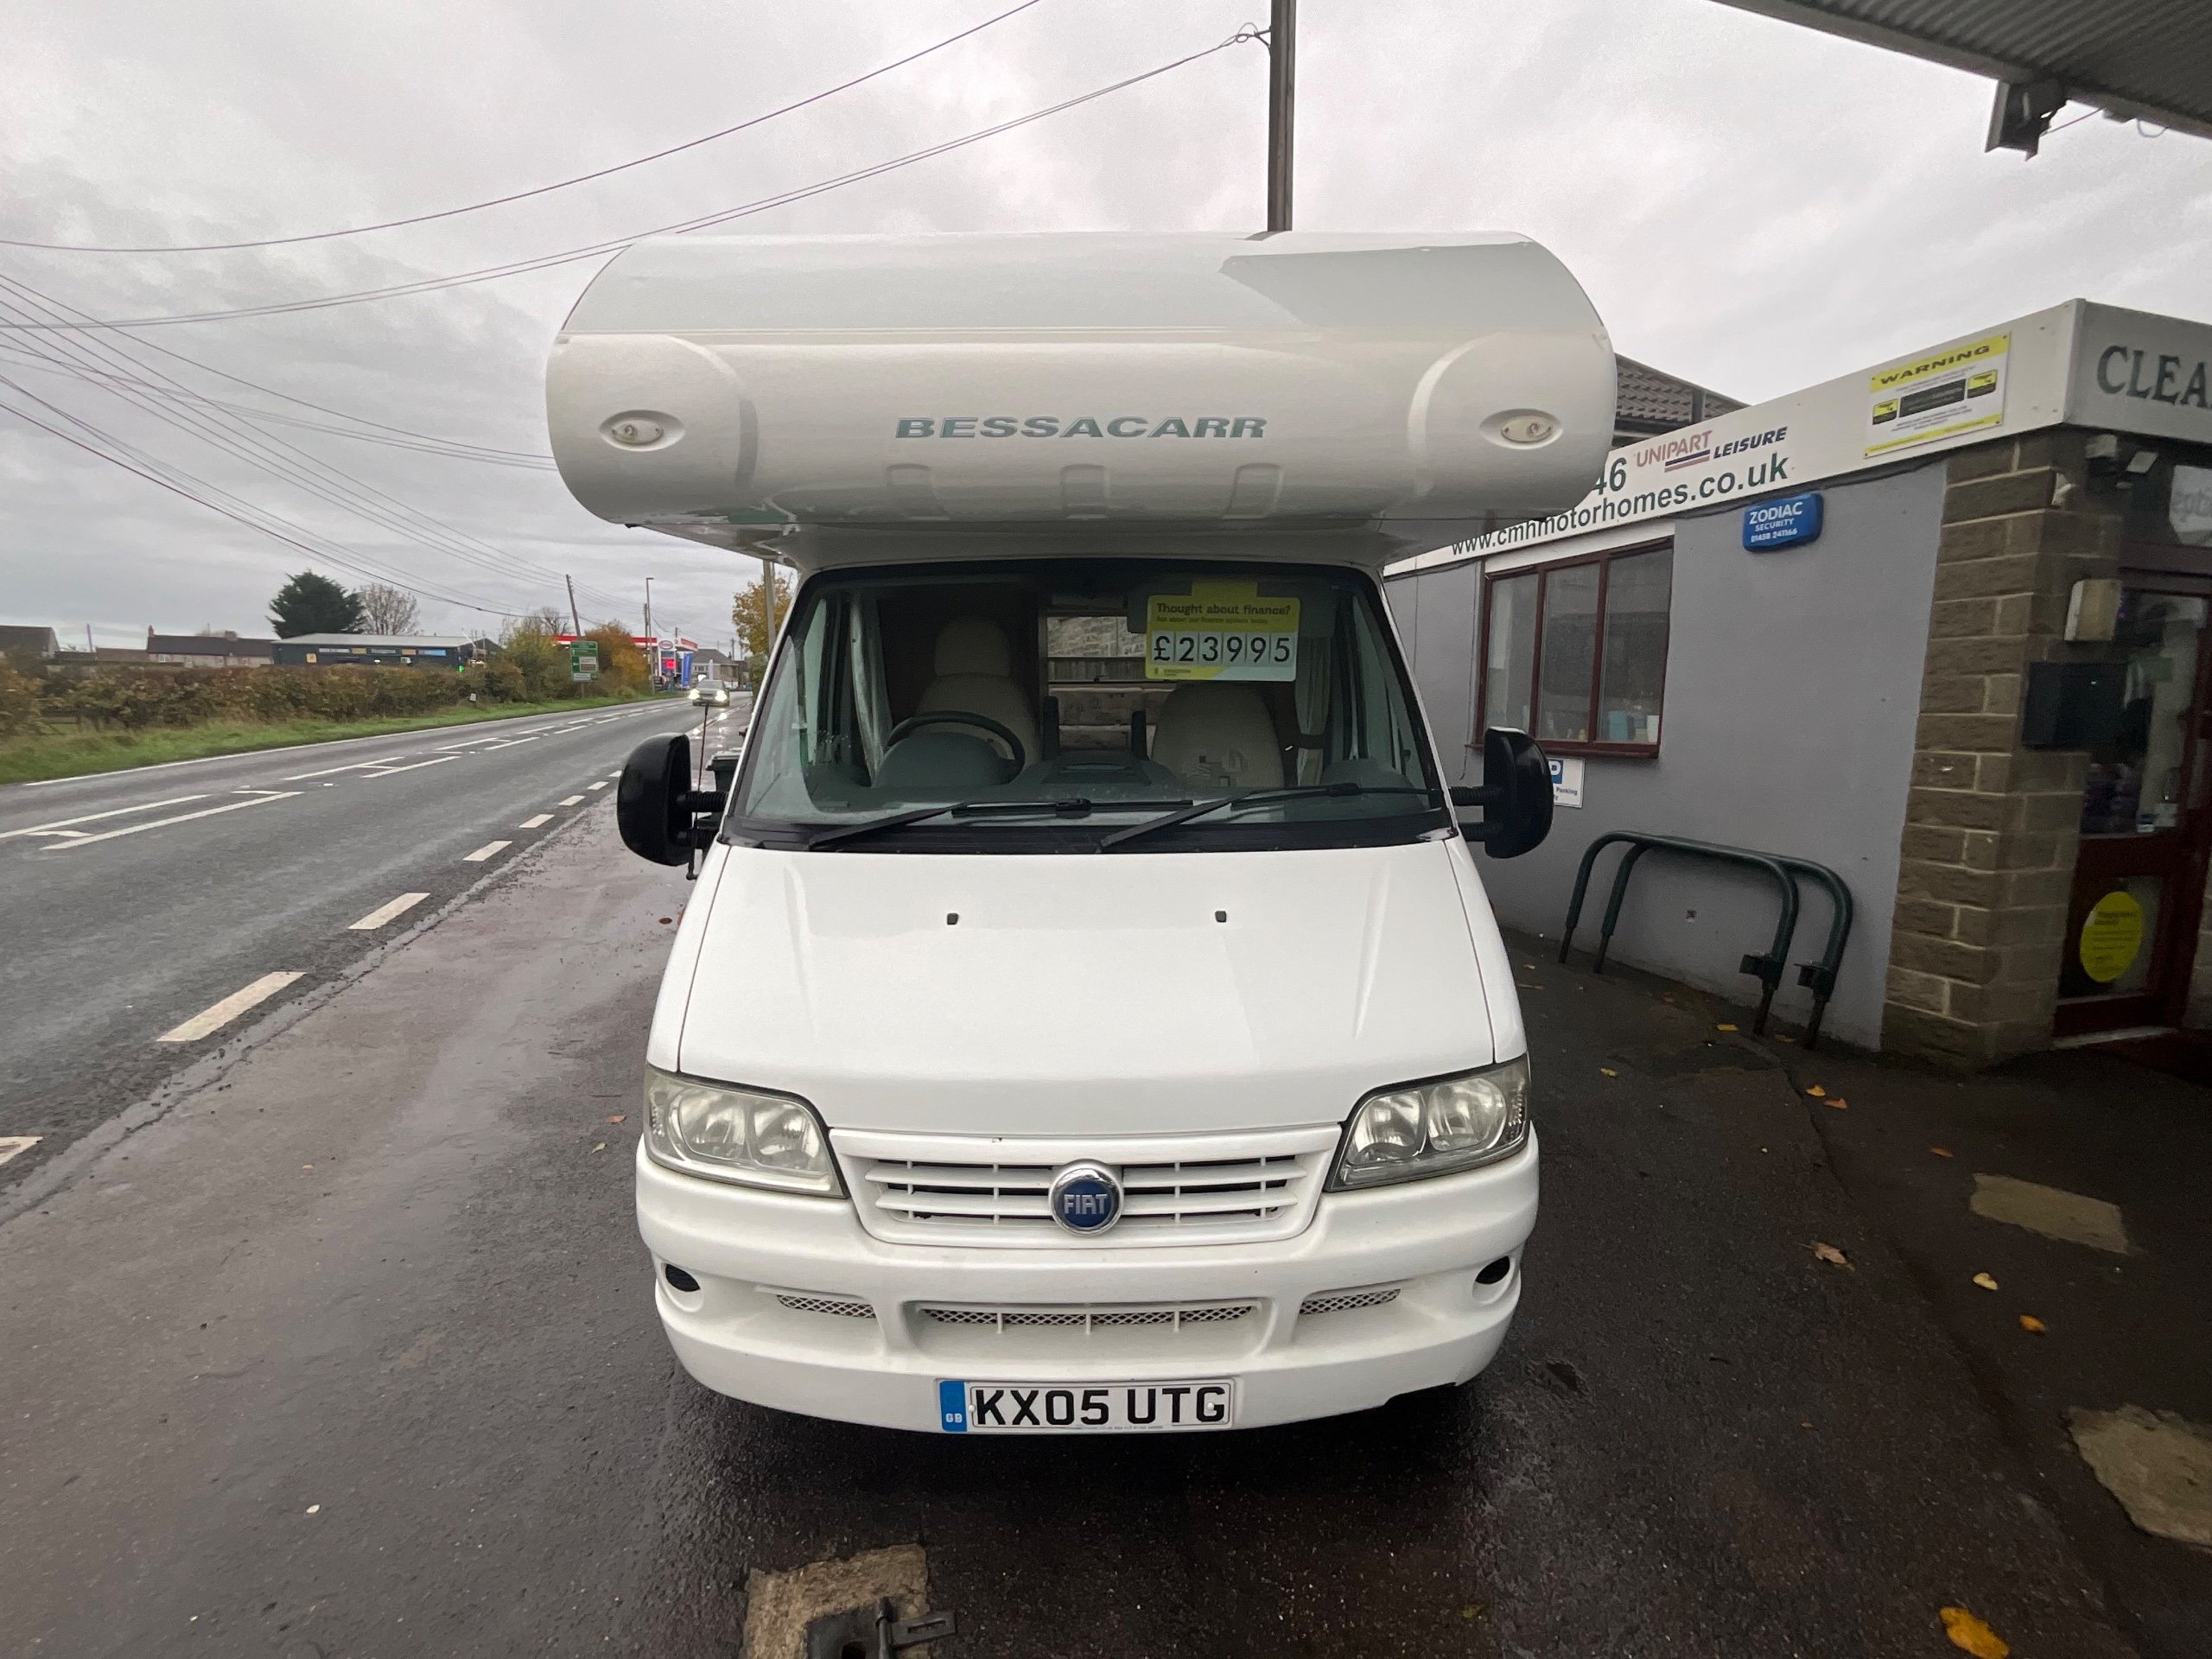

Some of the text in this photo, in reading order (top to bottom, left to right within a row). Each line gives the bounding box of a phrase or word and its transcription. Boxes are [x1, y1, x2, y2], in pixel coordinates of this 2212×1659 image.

[1881, 346, 1990, 385] WARNING
[2097, 345, 2212, 410] CLEA
[895, 416, 1268, 438] BESSACARR
[1637, 426, 1788, 467] UNIPART LEISURE
[1452, 453, 1789, 556] www.cmhmotorhomes.co.uk
[1749, 501, 1803, 524] ZODIAC
[1755, 518, 1795, 531] SECURITY
[1156, 602, 1291, 616] Thought about finance?
[1154, 635, 1290, 663] £23995
[1555, 786, 1578, 796] Parking
[1063, 1193, 1108, 1215] FIAT
[975, 1386, 1225, 1426] KX05 UTG
